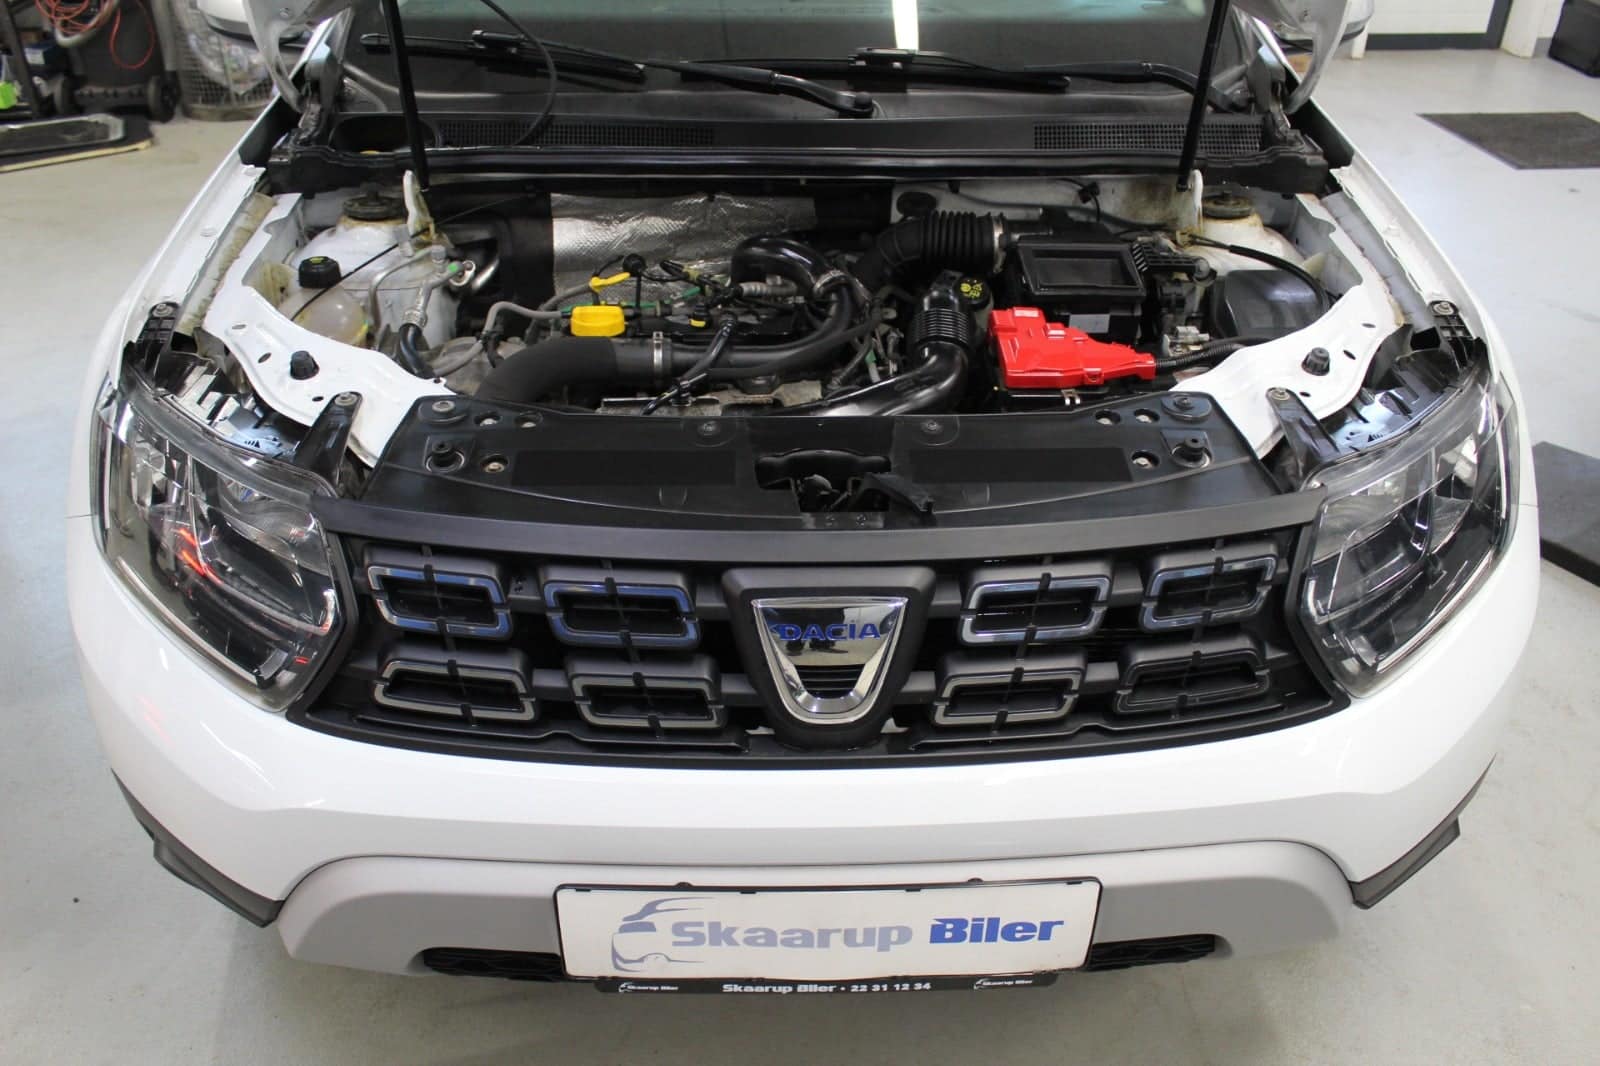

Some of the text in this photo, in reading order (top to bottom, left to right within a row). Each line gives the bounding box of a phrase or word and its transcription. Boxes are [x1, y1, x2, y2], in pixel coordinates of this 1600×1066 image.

[775, 623, 881, 641] DACIA
[671, 917, 1065, 952] Skaarup Biler
[722, 982, 932, 994] Skaarup Biler 22 31 12 34
